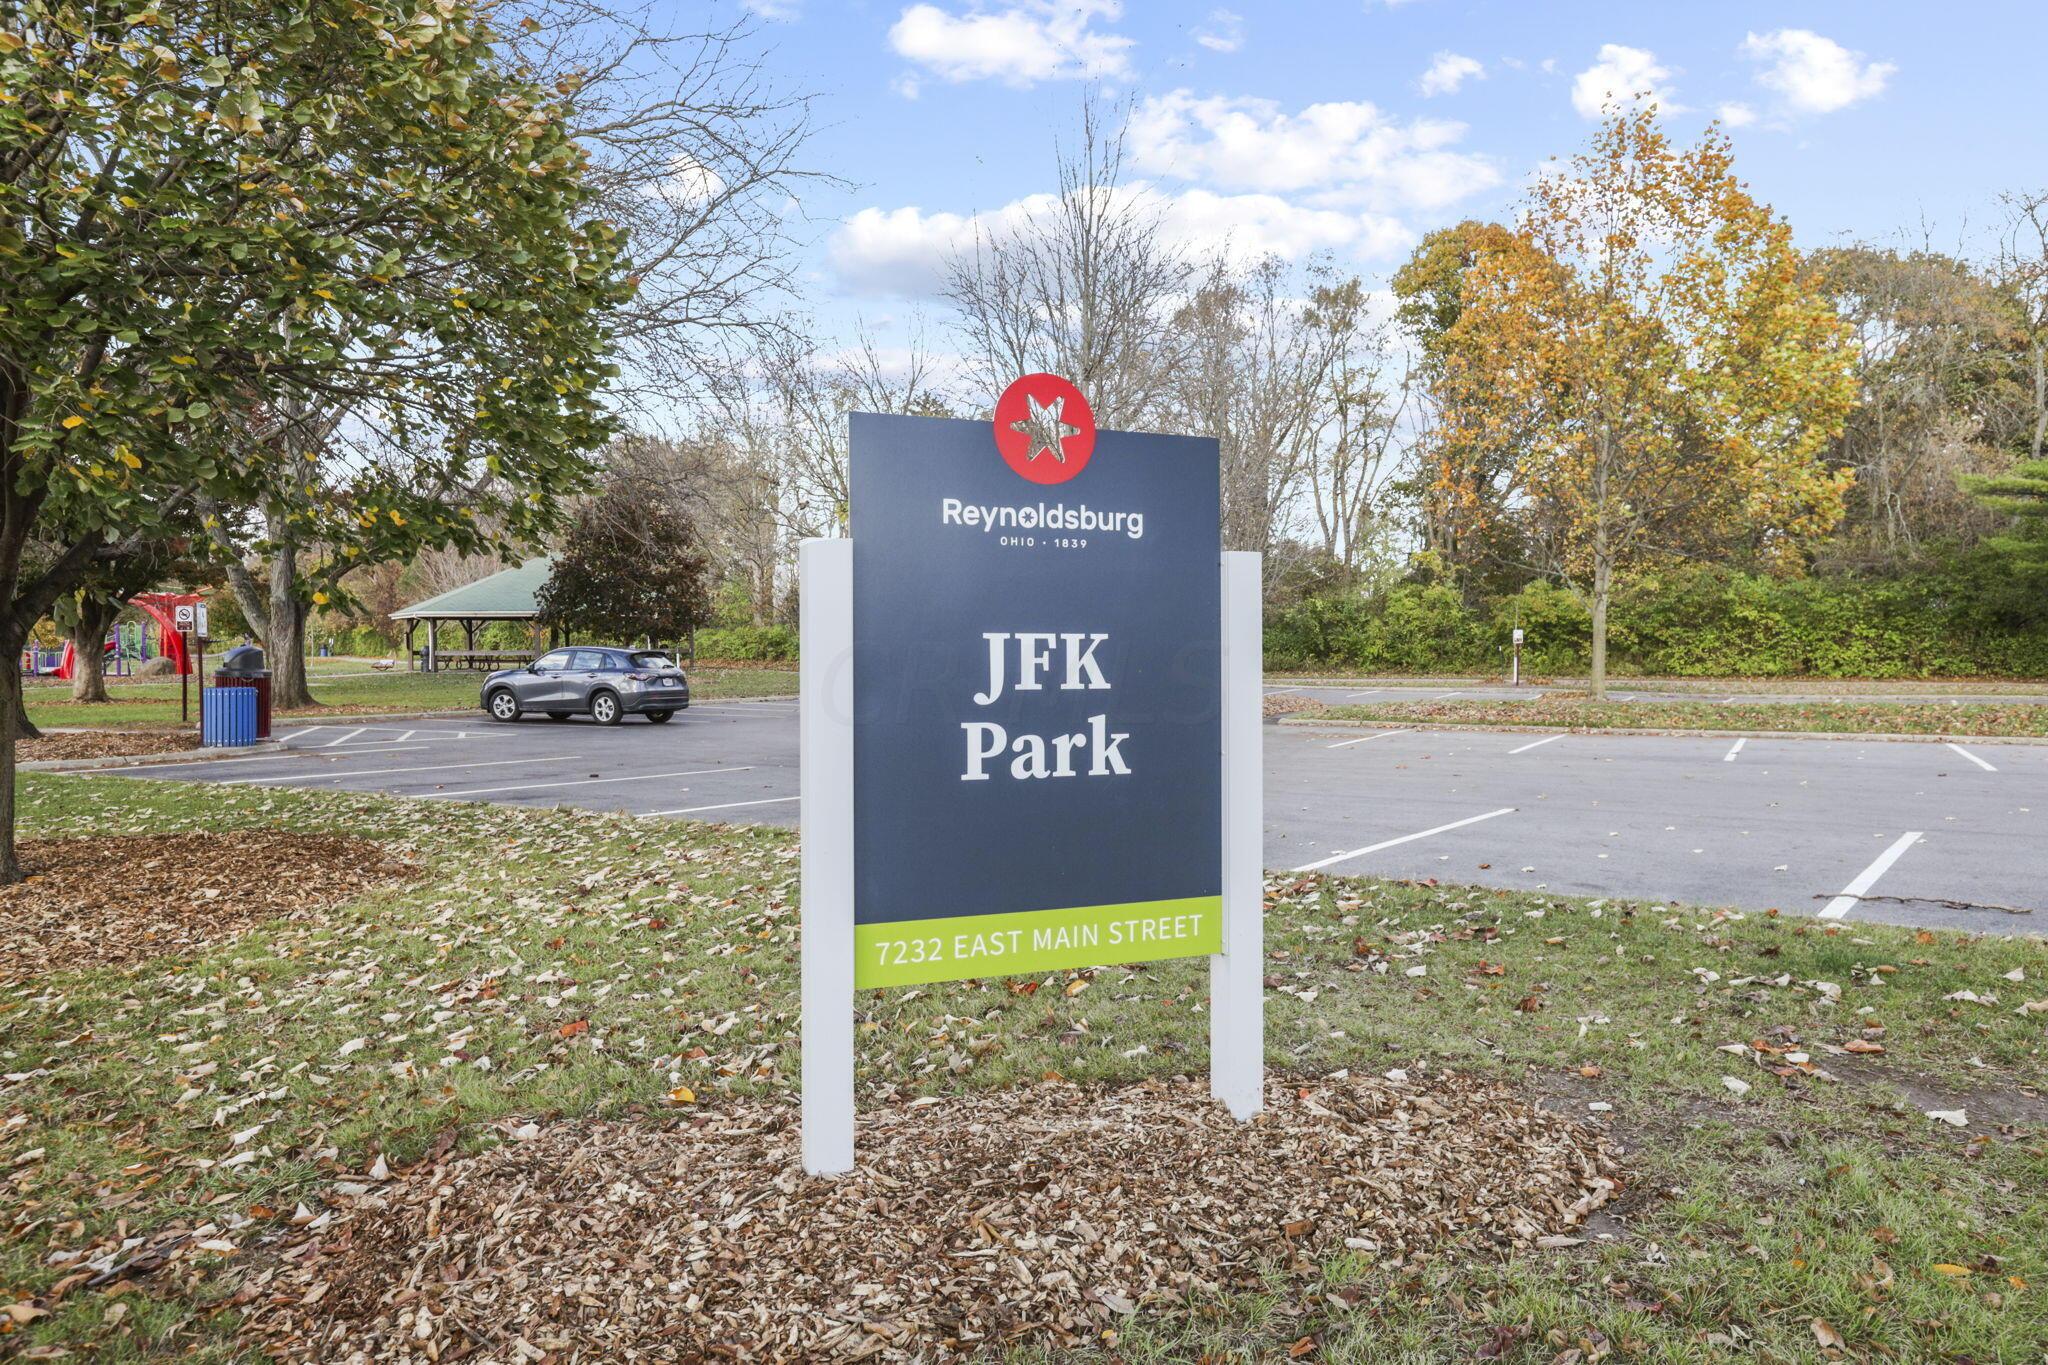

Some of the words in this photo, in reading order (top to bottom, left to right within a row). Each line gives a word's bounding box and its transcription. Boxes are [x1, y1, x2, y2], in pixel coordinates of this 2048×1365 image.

[942, 498, 1144, 539] Reynoldsburg
[999, 535, 1035, 547] OHIO
[1053, 538, 1088, 548] 1839
[973, 632, 1112, 706] JFK
[960, 713, 1132, 781] Park
[875, 937, 944, 966] 7232
[954, 930, 1023, 959] EAST
[1032, 924, 1099, 951] MAIN
[1108, 914, 1203, 944] STREET
